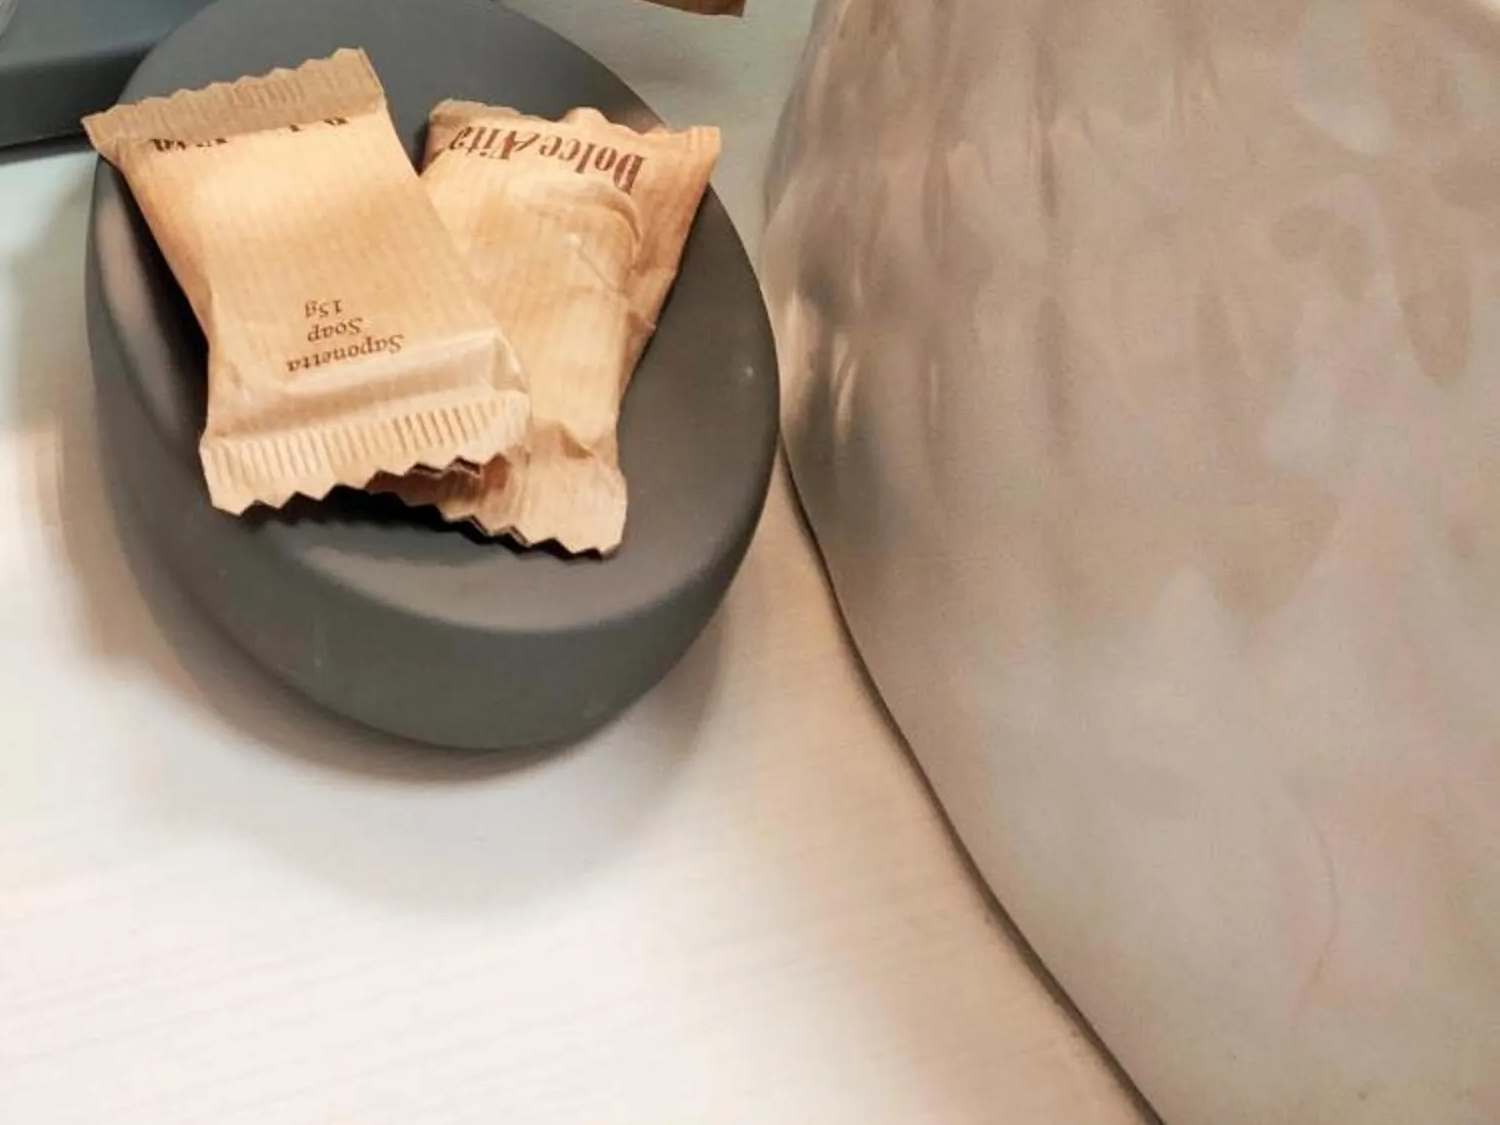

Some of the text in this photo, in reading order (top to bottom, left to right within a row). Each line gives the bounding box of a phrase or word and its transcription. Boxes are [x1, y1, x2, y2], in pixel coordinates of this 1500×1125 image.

[304, 298, 343, 318] 15g
[307, 316, 364, 343] Soap
[286, 334, 404, 372] Saponetta
